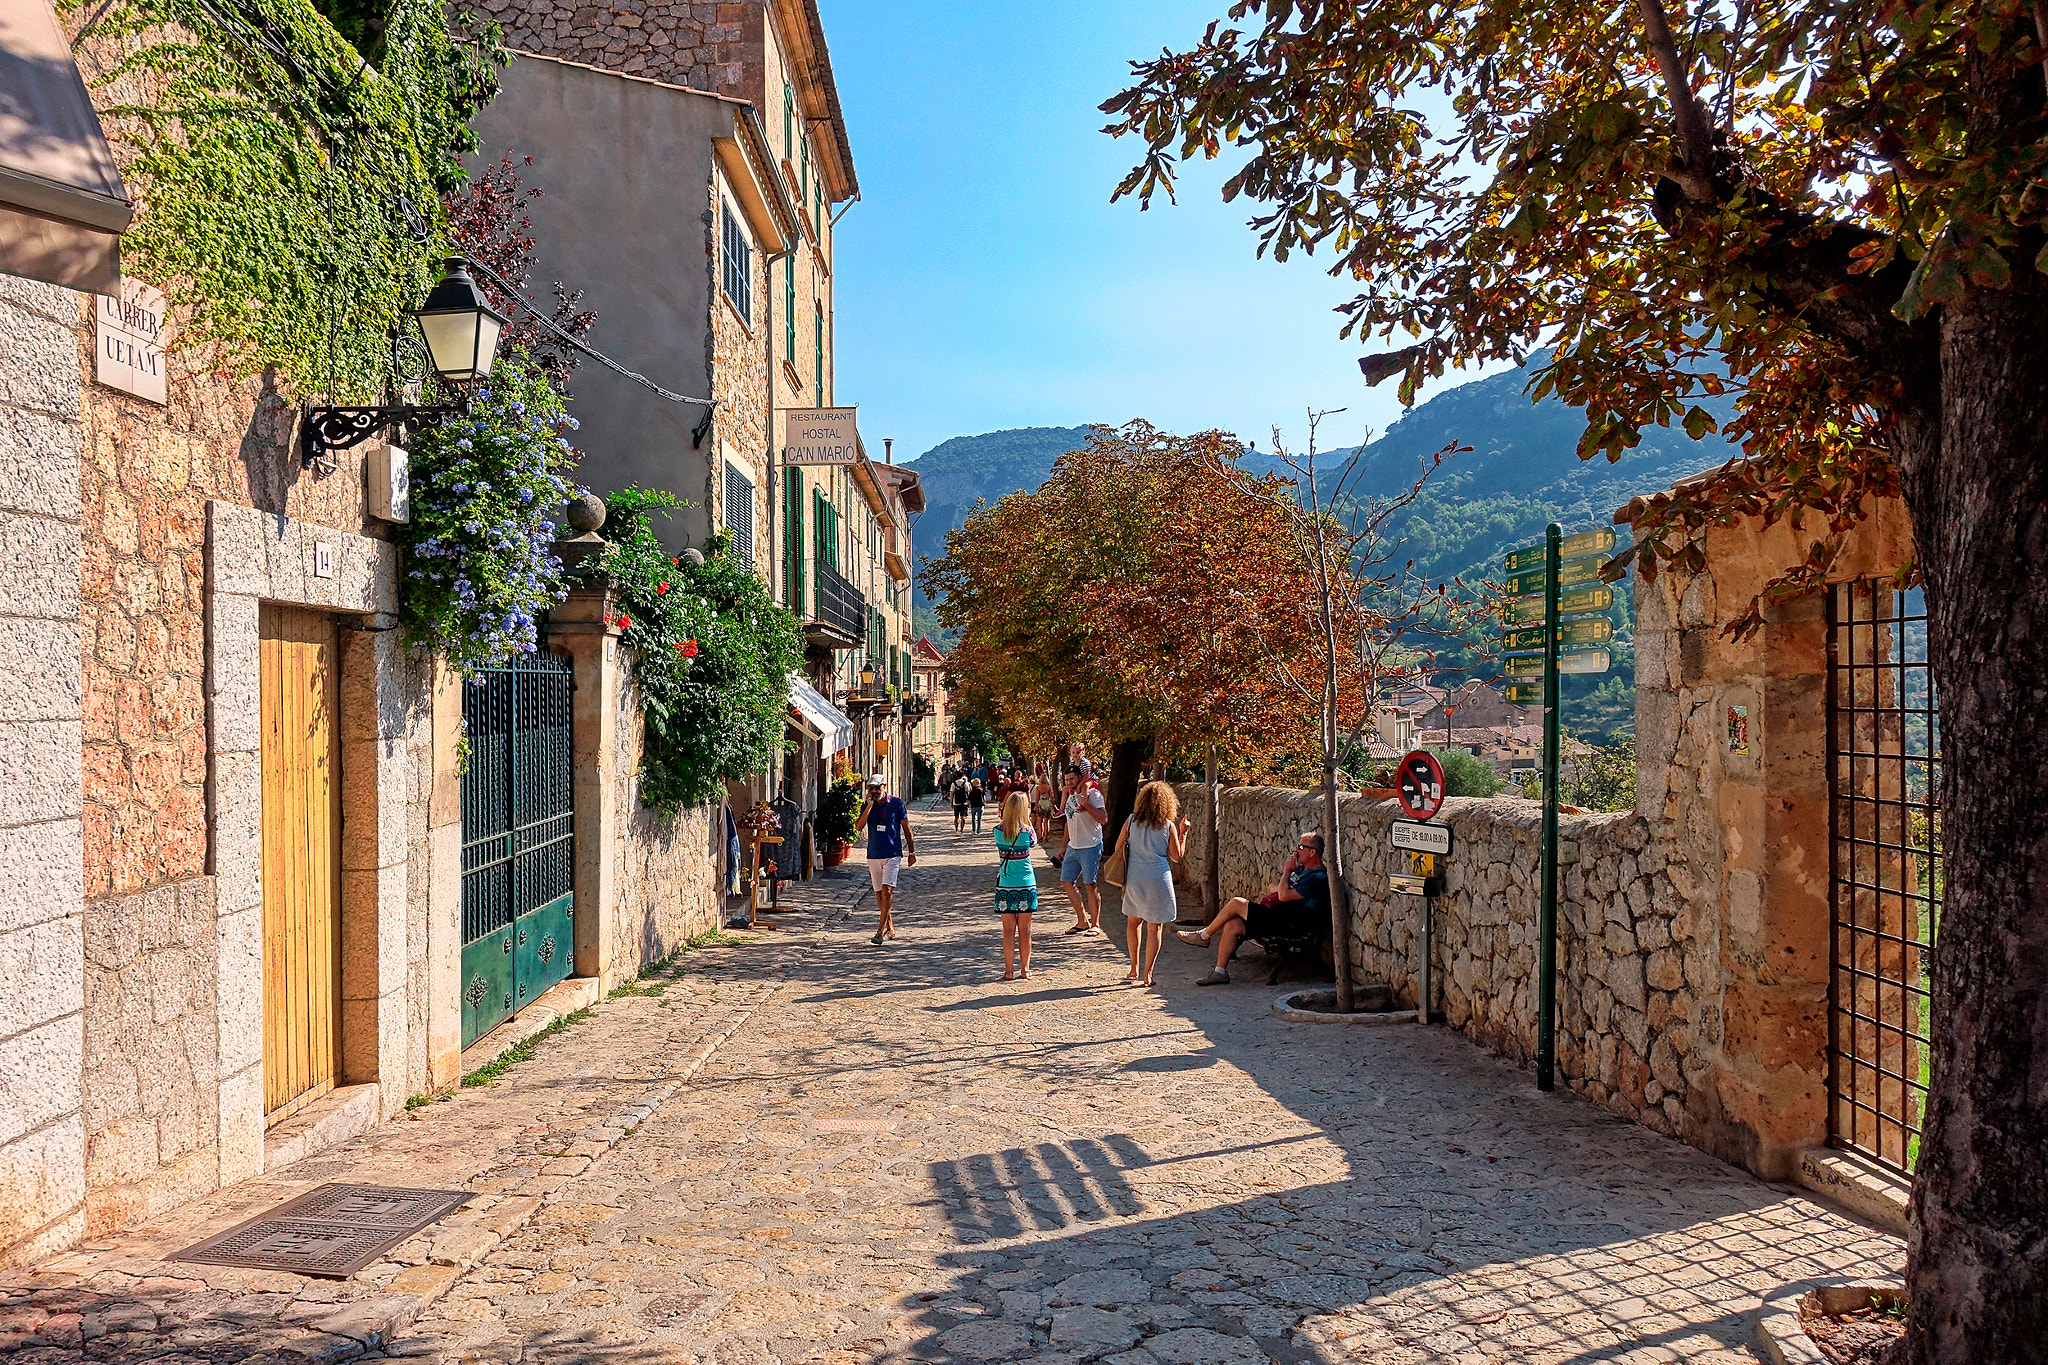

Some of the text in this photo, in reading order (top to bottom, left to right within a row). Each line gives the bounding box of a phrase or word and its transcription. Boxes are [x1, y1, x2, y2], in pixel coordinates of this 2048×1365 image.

[106, 297, 158, 336] CARRER
[105, 335, 158, 377] UETAM
[790, 412, 853, 422] RESTAURANT
[802, 428, 842, 439] HOSTAL
[787, 442, 855, 461] CA'N MARIÓ
[320, 550, 329, 571] 14
[1411, 831, 1419, 841] DE
